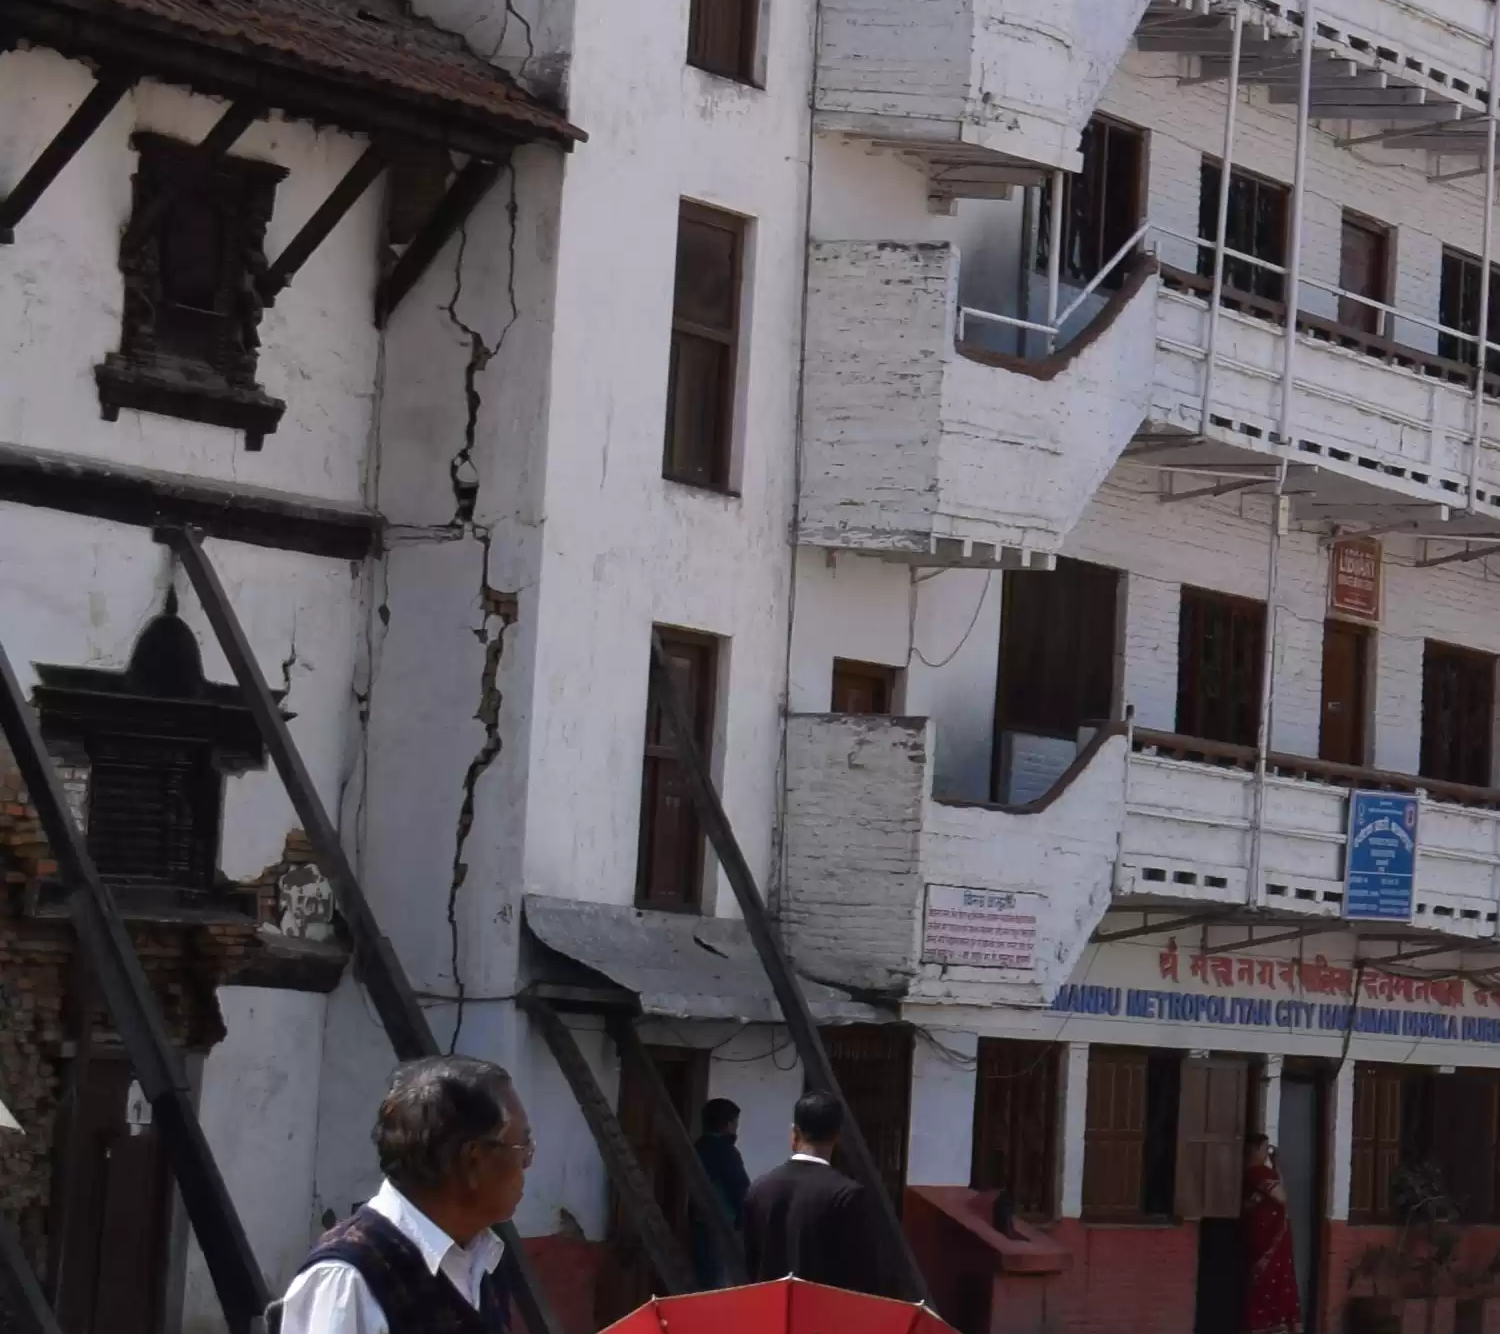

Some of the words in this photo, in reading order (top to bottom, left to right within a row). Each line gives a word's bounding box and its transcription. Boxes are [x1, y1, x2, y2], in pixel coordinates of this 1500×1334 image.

[1126, 988, 1271, 1026] METROPOLITAN
[1275, 999, 1316, 1029] CITY
[1402, 1010, 1459, 1040] DHOKA
